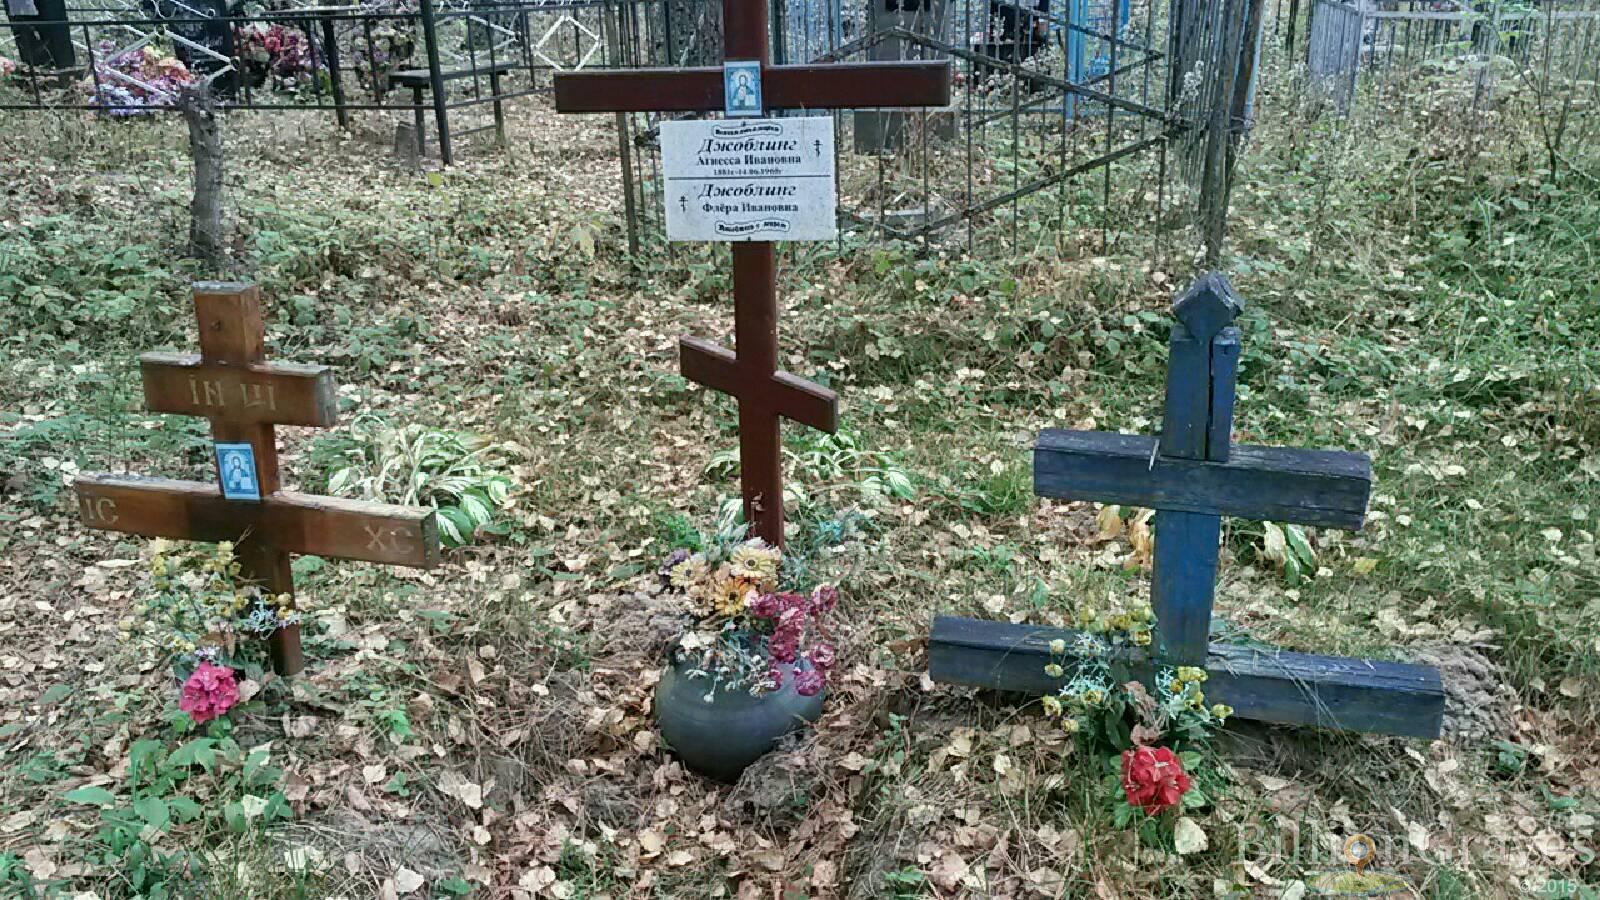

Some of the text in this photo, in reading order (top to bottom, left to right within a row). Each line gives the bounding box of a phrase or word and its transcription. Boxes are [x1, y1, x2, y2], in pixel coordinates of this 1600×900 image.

[698, 138, 796, 153] Джоблинг
[696, 153, 802, 166] Агнесса Ивановна
[698, 184, 796, 199] Джоблинг
[702, 201, 799, 215] Флёра Ивановна
